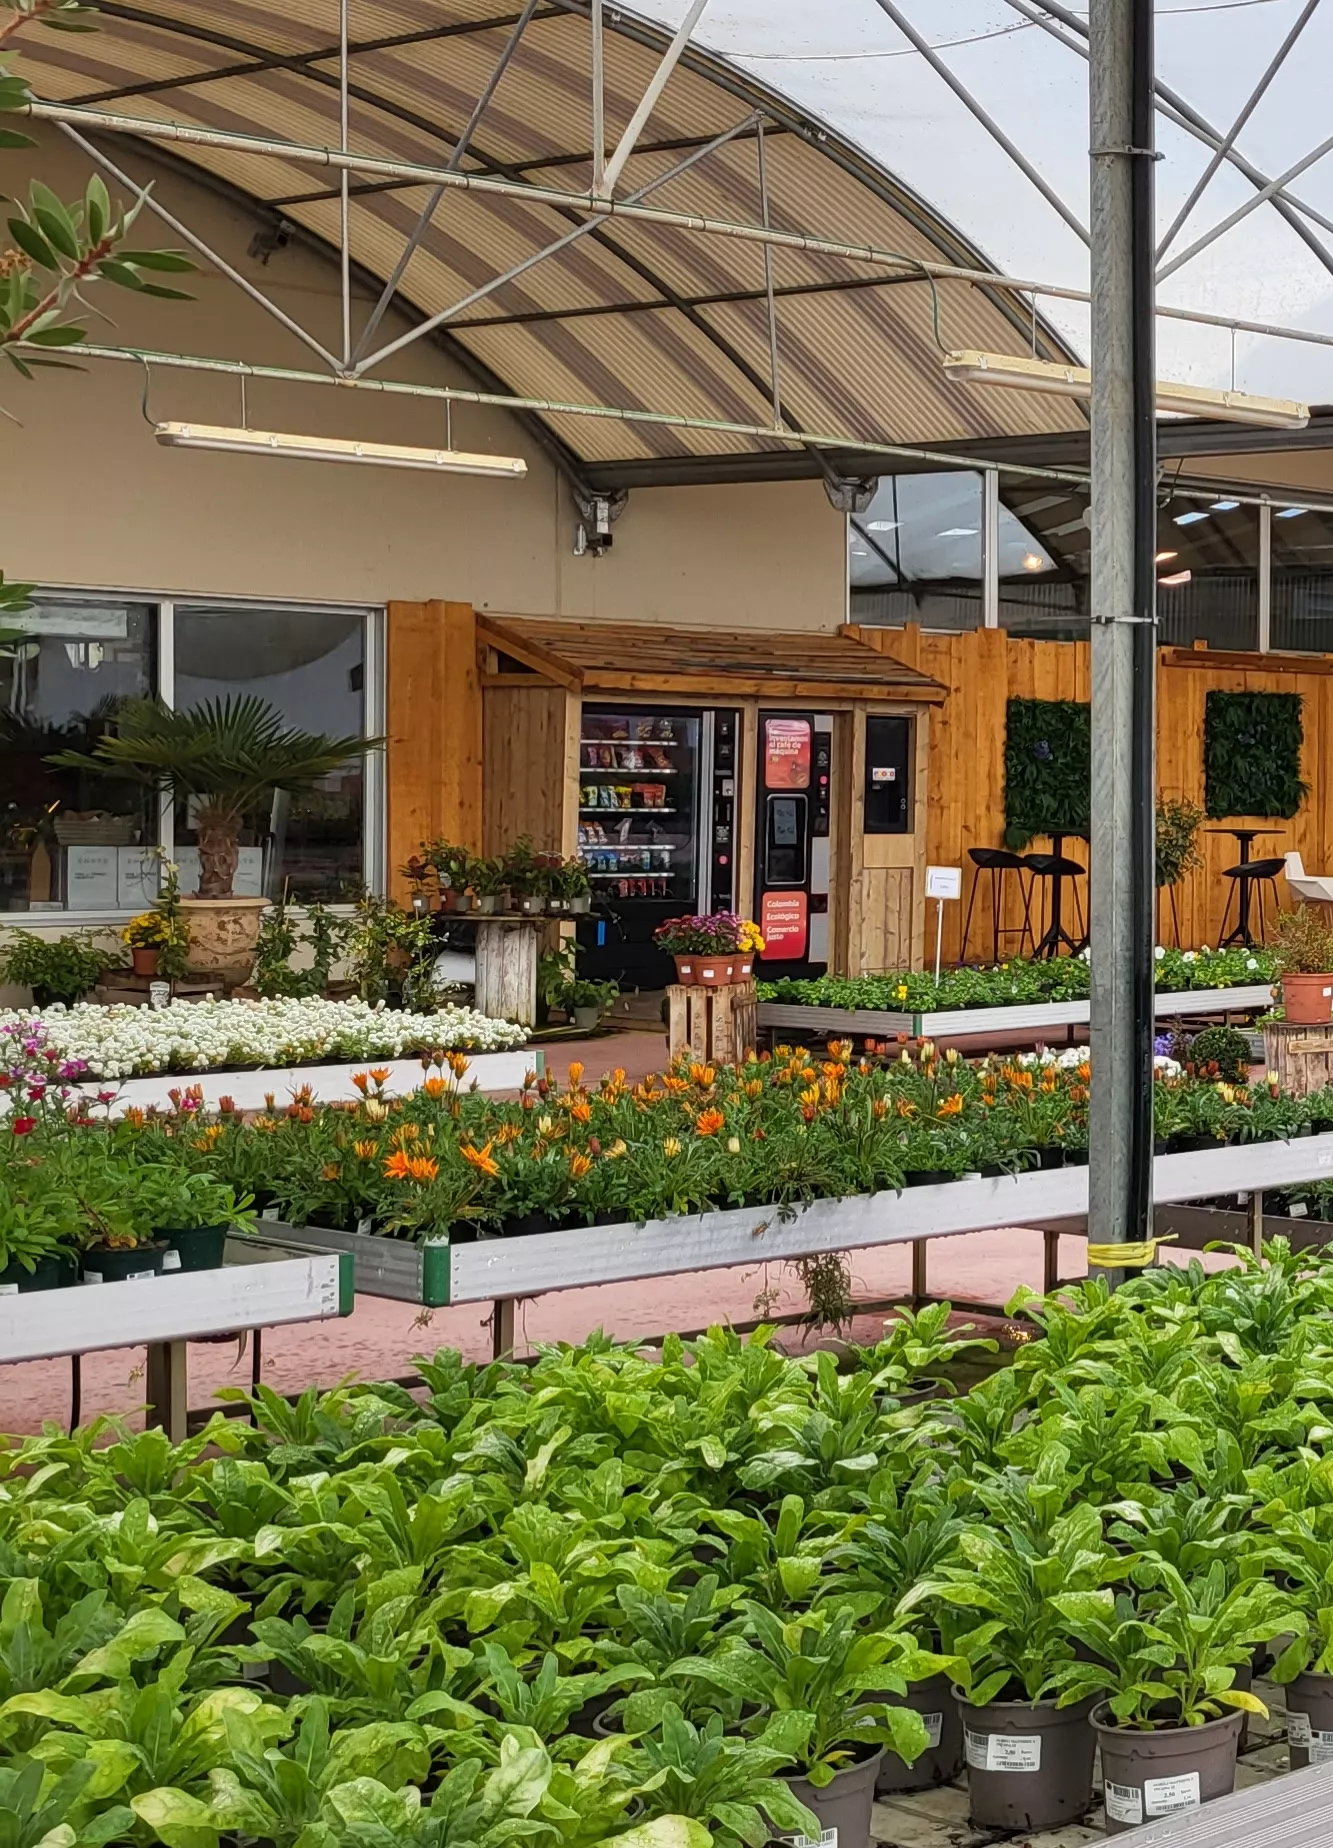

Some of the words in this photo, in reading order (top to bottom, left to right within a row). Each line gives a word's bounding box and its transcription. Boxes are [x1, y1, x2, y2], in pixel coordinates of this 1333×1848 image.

[767, 900, 800, 908] Colombia
[766, 912, 800, 921] Ecológico
[766, 925, 800, 933] Comercio
